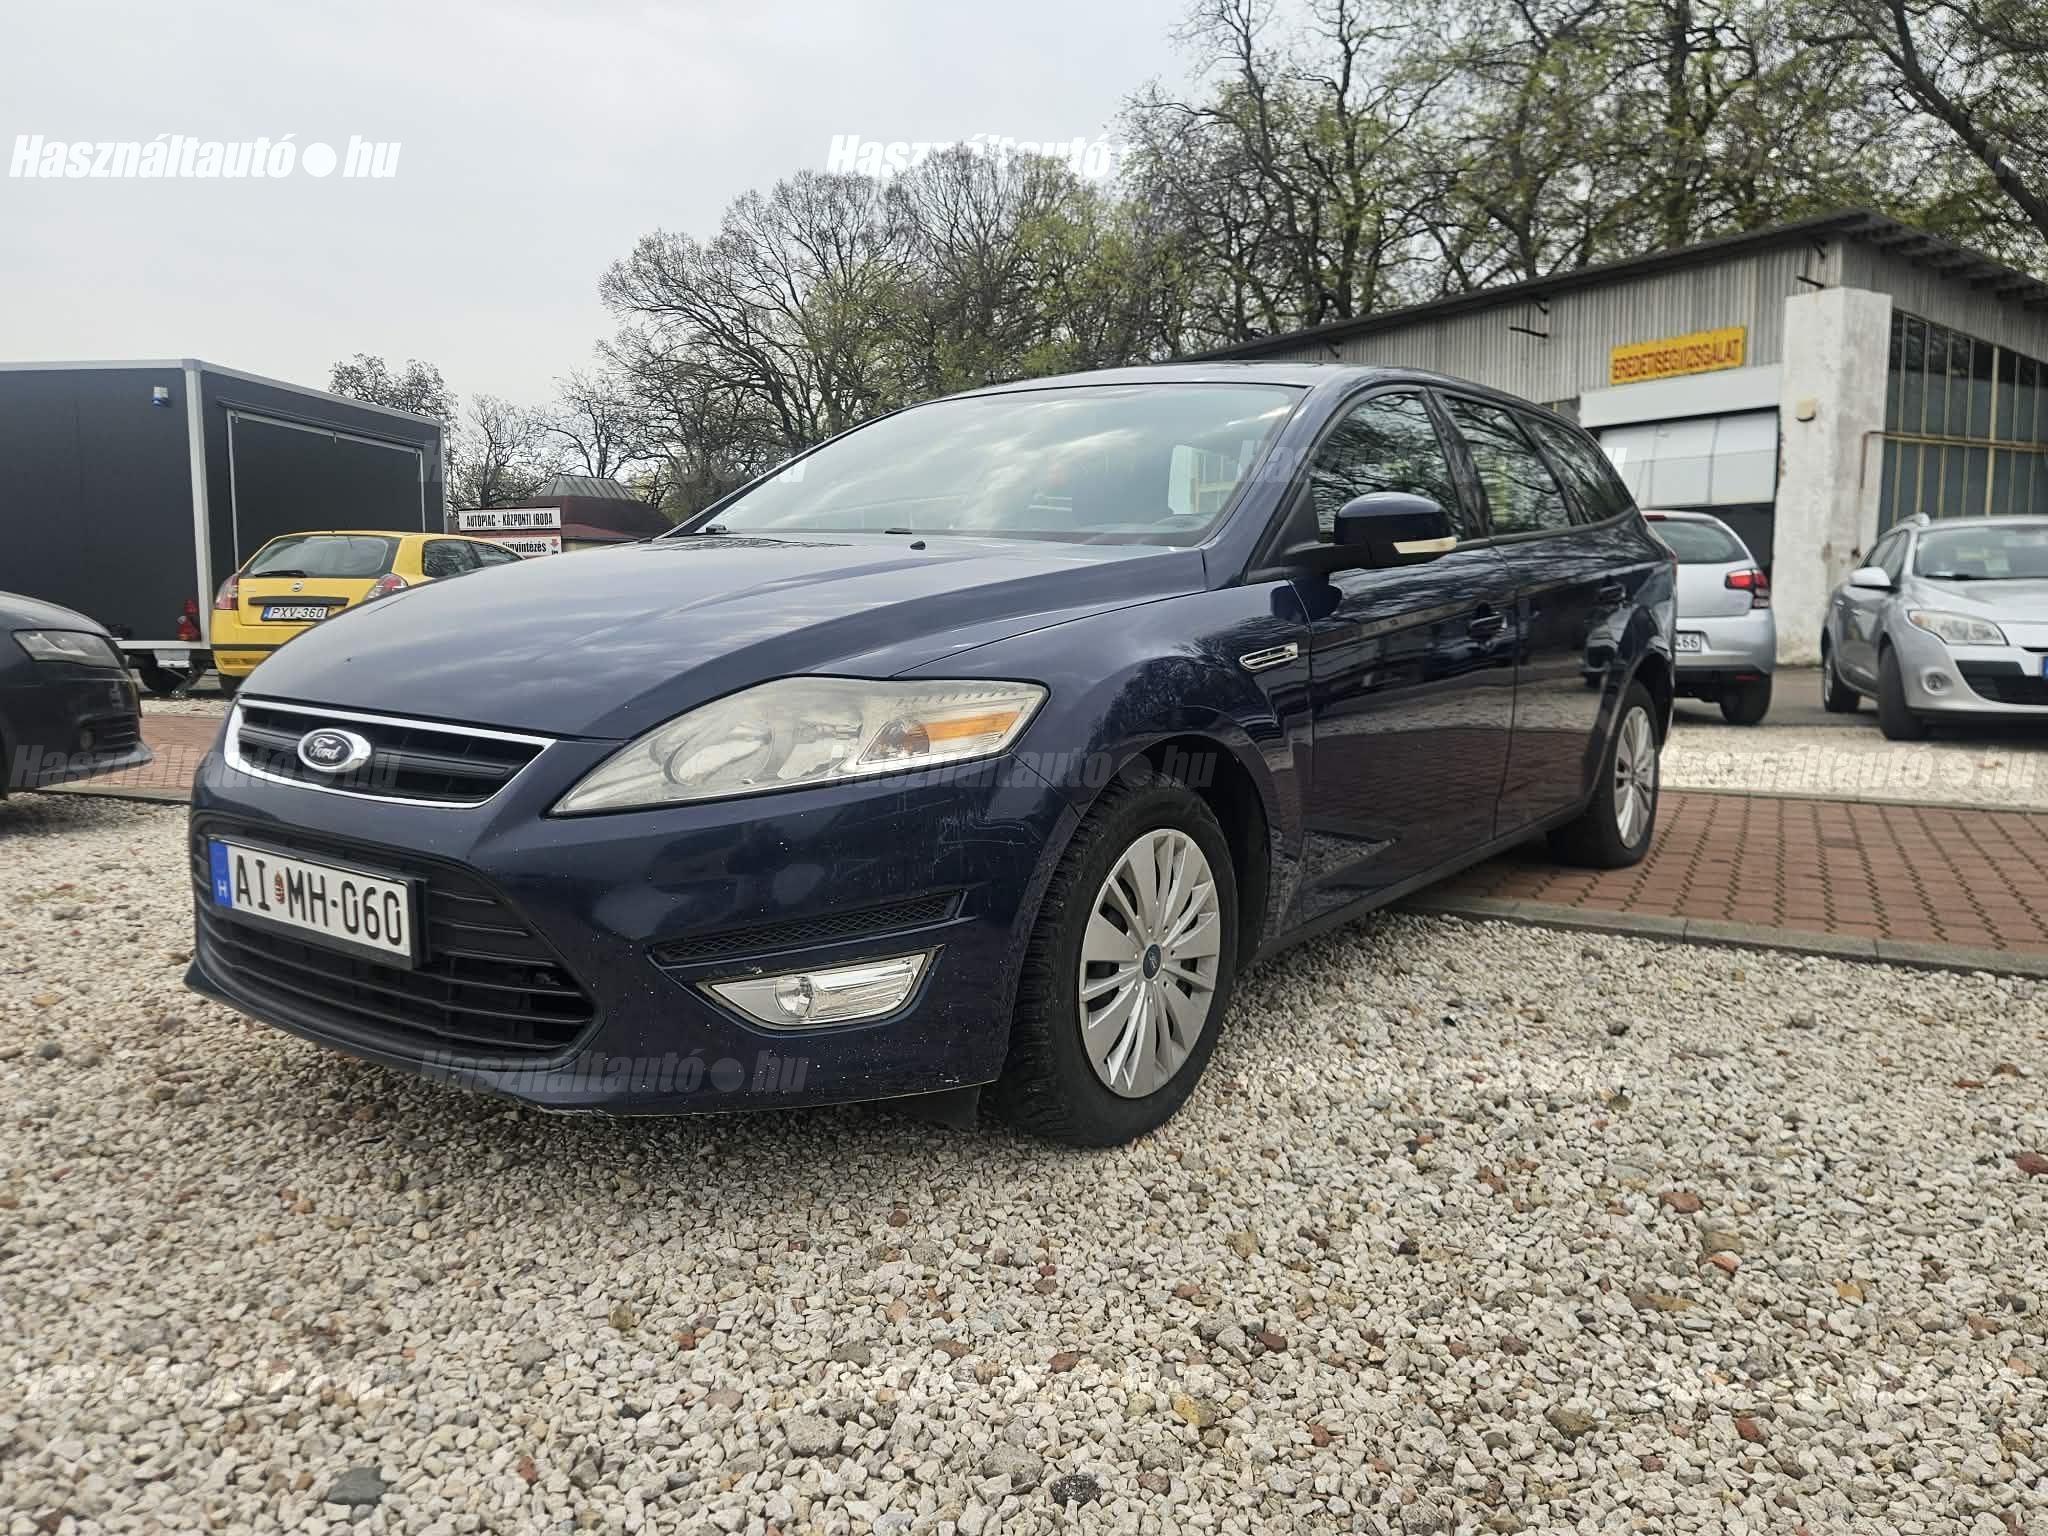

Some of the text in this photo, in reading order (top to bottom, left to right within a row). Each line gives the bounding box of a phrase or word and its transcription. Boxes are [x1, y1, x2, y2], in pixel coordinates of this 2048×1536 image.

[533, 512, 553, 526] IRODA
[271, 607, 325, 618] PXV-360
[308, 737, 342, 760] Ford
